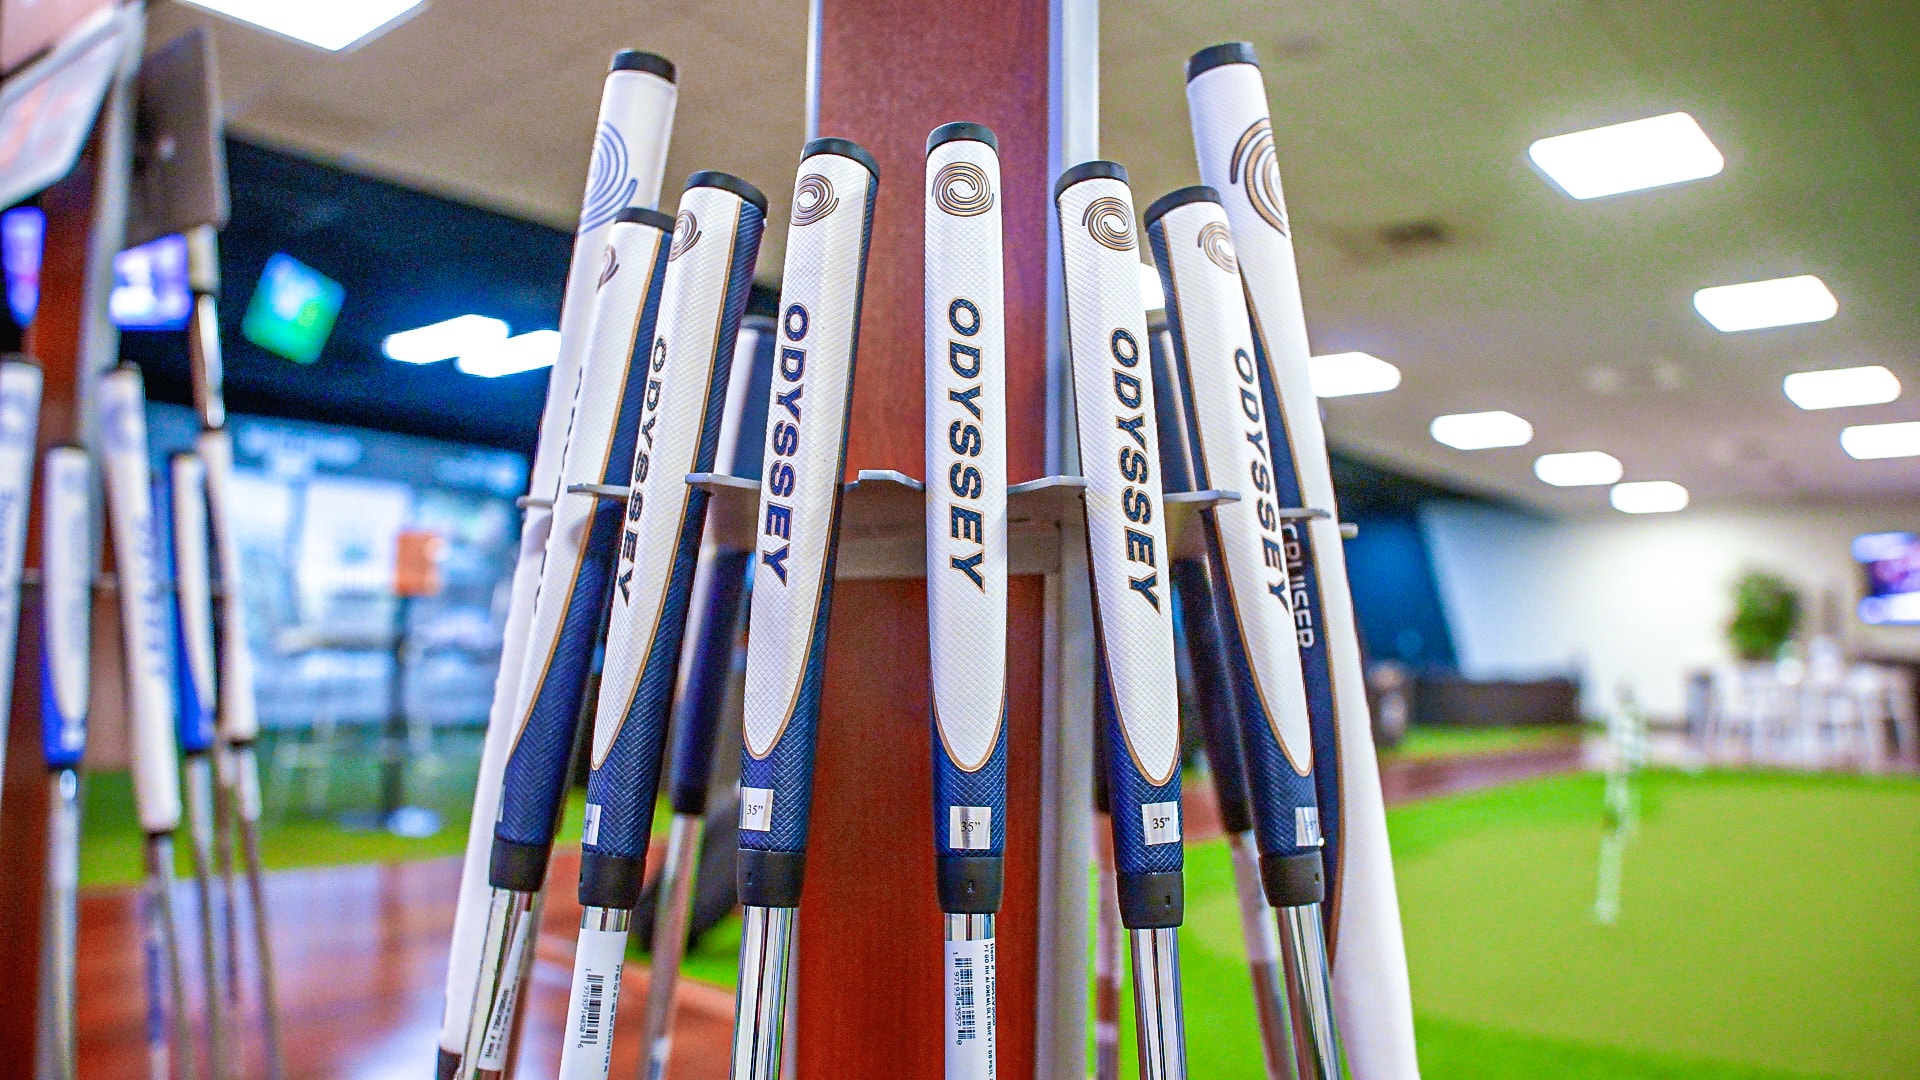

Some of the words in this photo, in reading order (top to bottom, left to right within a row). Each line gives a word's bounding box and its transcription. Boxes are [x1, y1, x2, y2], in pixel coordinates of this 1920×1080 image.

[617, 334, 667, 609] ODYSSEY
[762, 302, 811, 588] ODYSSEY
[947, 295, 986, 595] ODYSSEY
[1110, 327, 1161, 615] ODYSSEY
[1234, 347, 1290, 616] ODYSSEY
